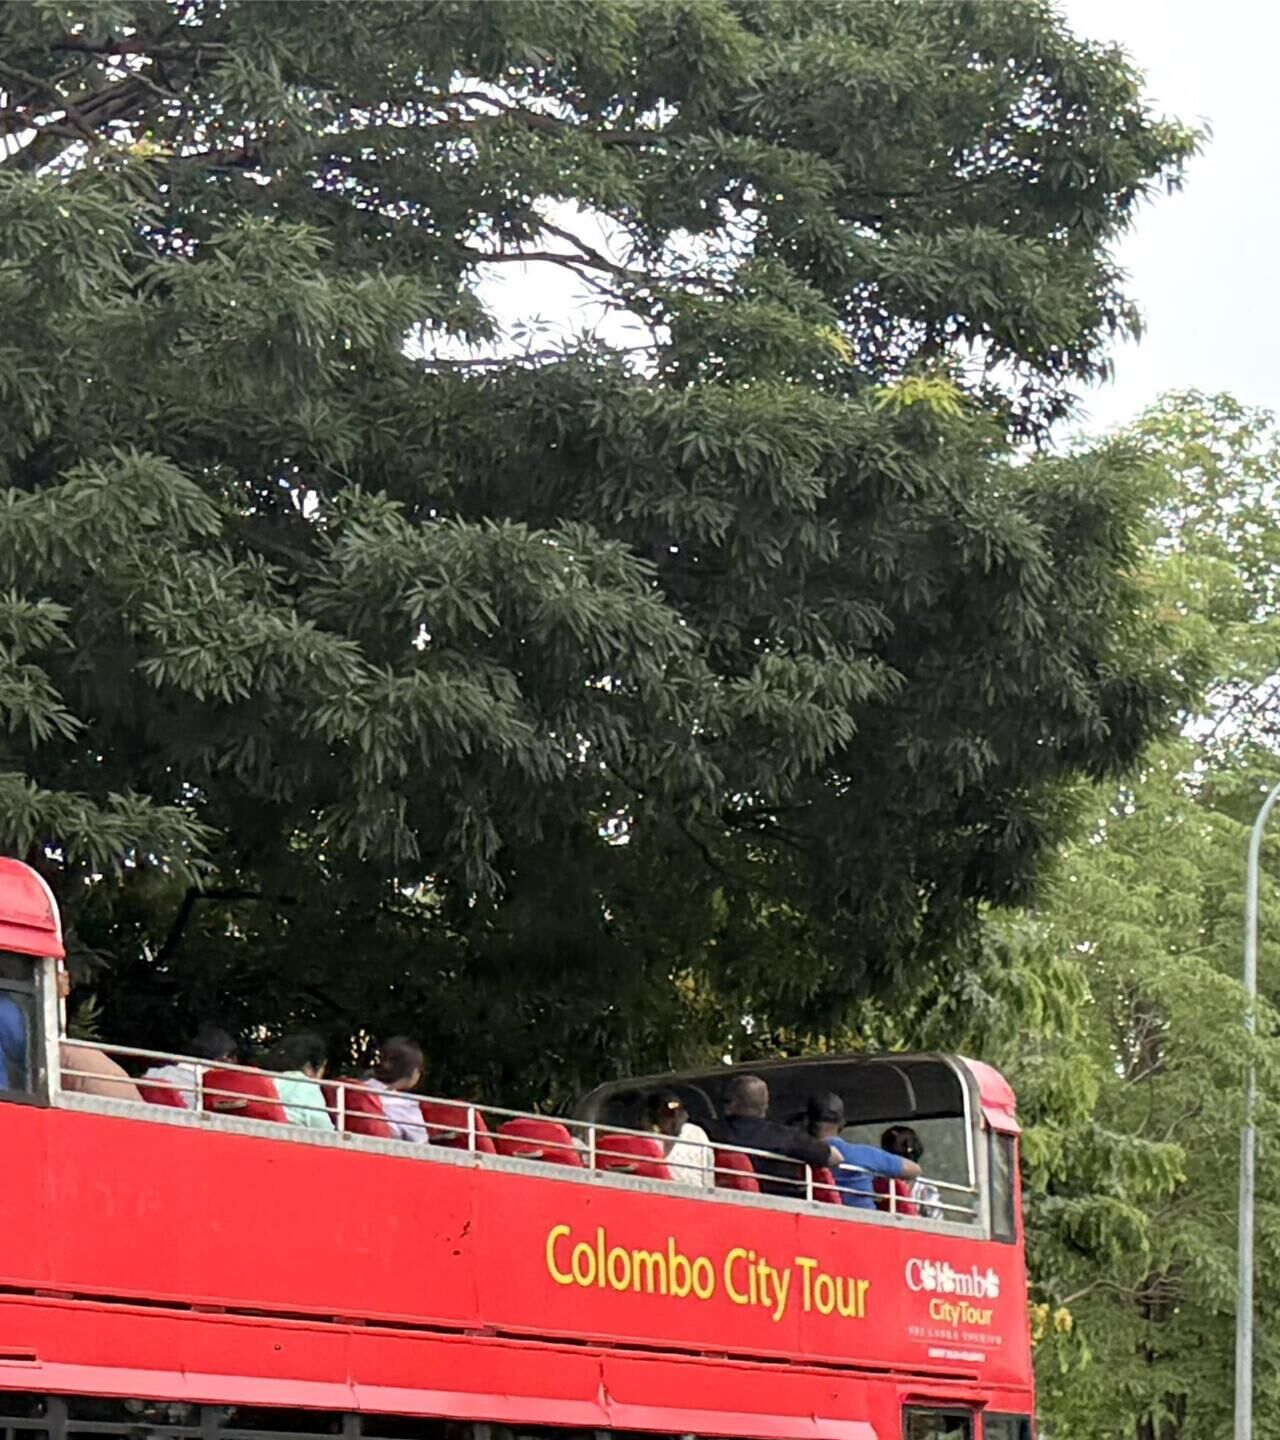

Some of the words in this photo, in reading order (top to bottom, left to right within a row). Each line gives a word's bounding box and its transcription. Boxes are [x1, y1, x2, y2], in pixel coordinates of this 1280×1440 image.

[546, 1223, 715, 1299] Colombo
[724, 1246, 790, 1322] City
[795, 1256, 870, 1318] Tour
[929, 1298, 993, 1327] CityTour
